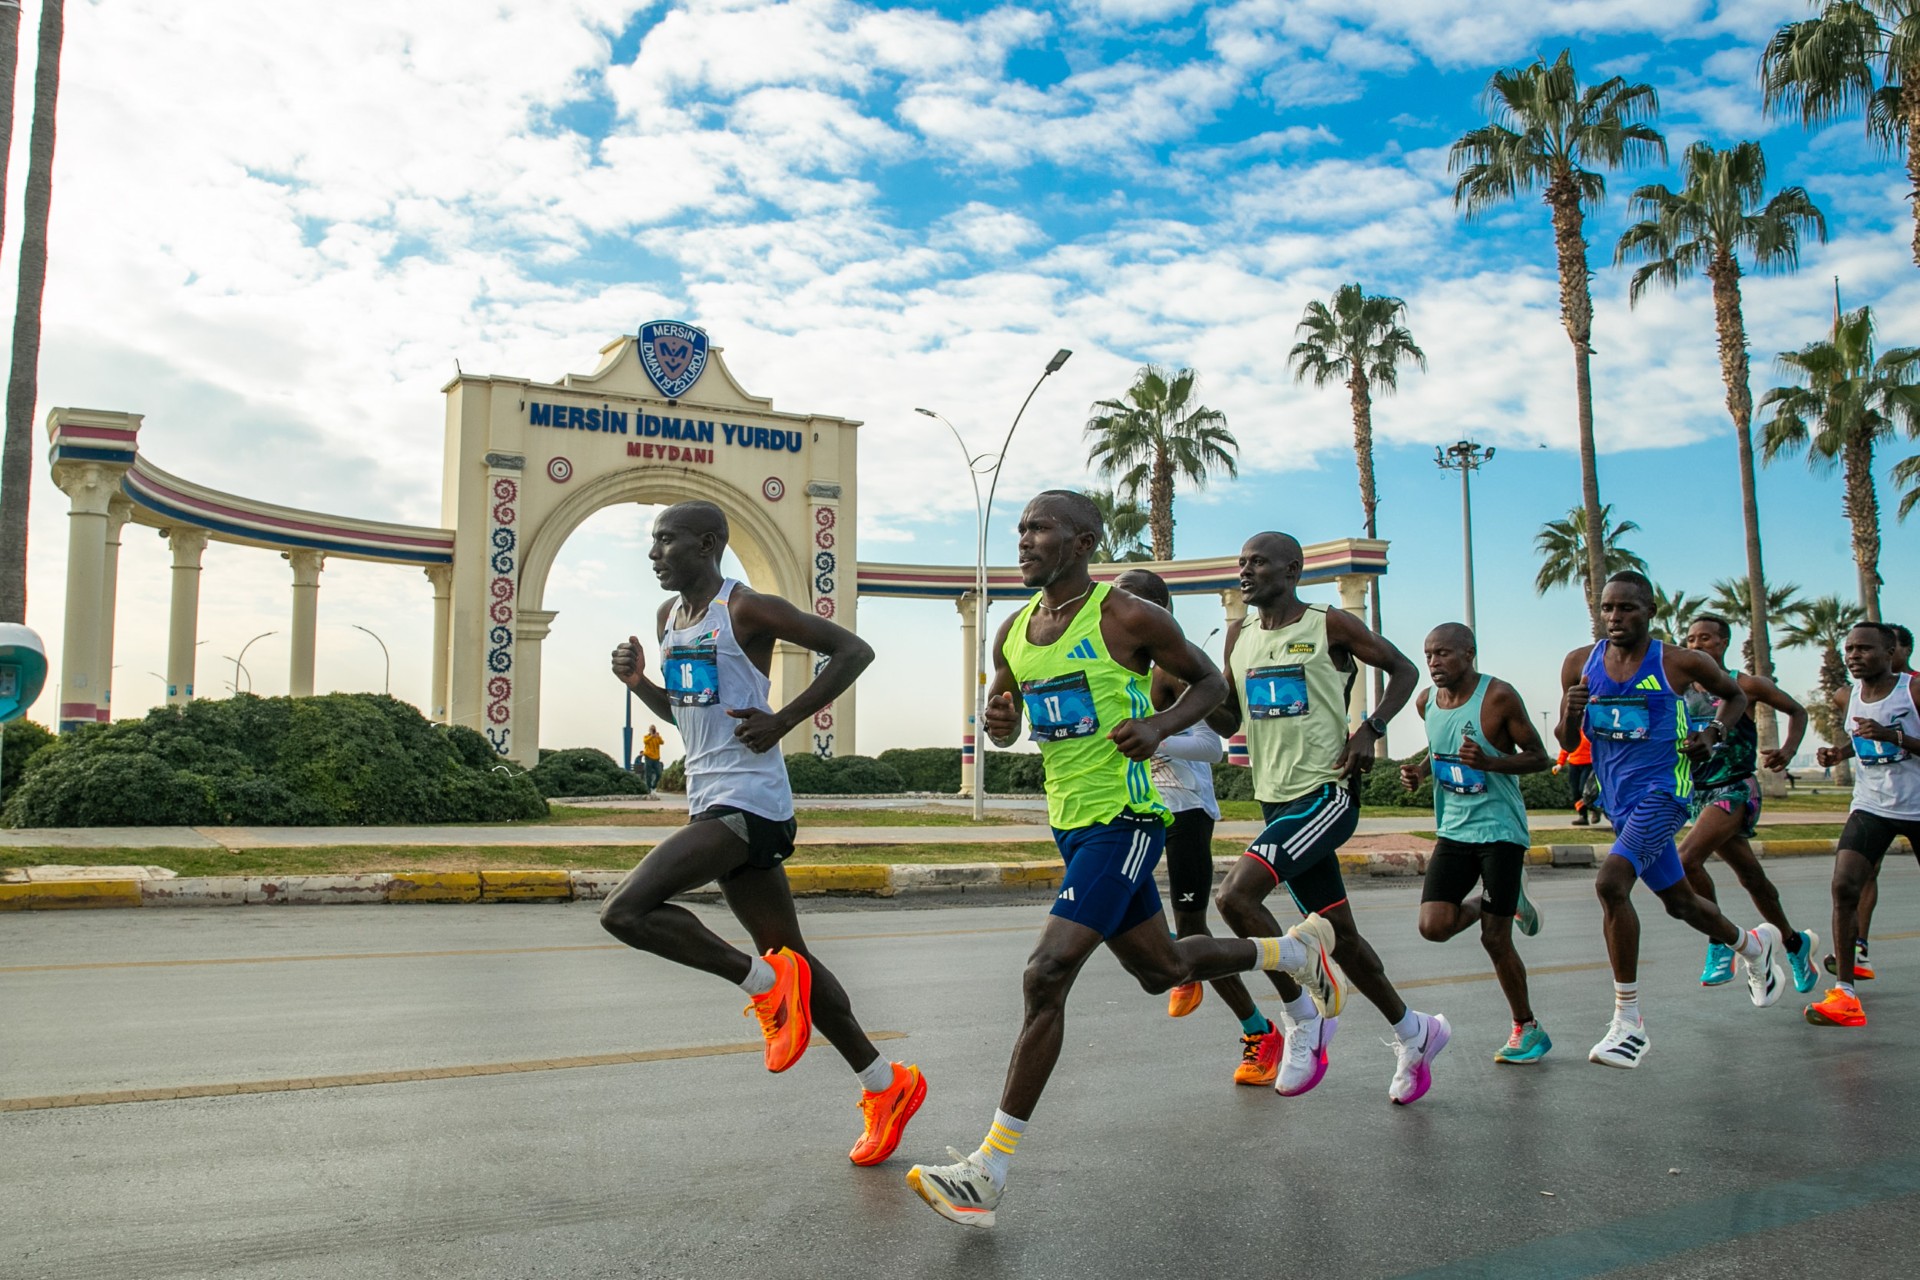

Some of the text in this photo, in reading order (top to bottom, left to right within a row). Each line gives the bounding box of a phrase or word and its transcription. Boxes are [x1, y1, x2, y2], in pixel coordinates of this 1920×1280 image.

[681, 349, 704, 382] YURDU
[660, 377, 686, 391] 1925
[530, 402, 802, 453] MERSİN İDMAN YURDU
[627, 441, 714, 464] MEYDANI
[680, 663, 693, 688] 16
[1269, 681, 1276, 702] 1
[1044, 696, 1062, 722] 17
[1612, 708, 1620, 727] 2
[1055, 729, 1067, 737] 42K
